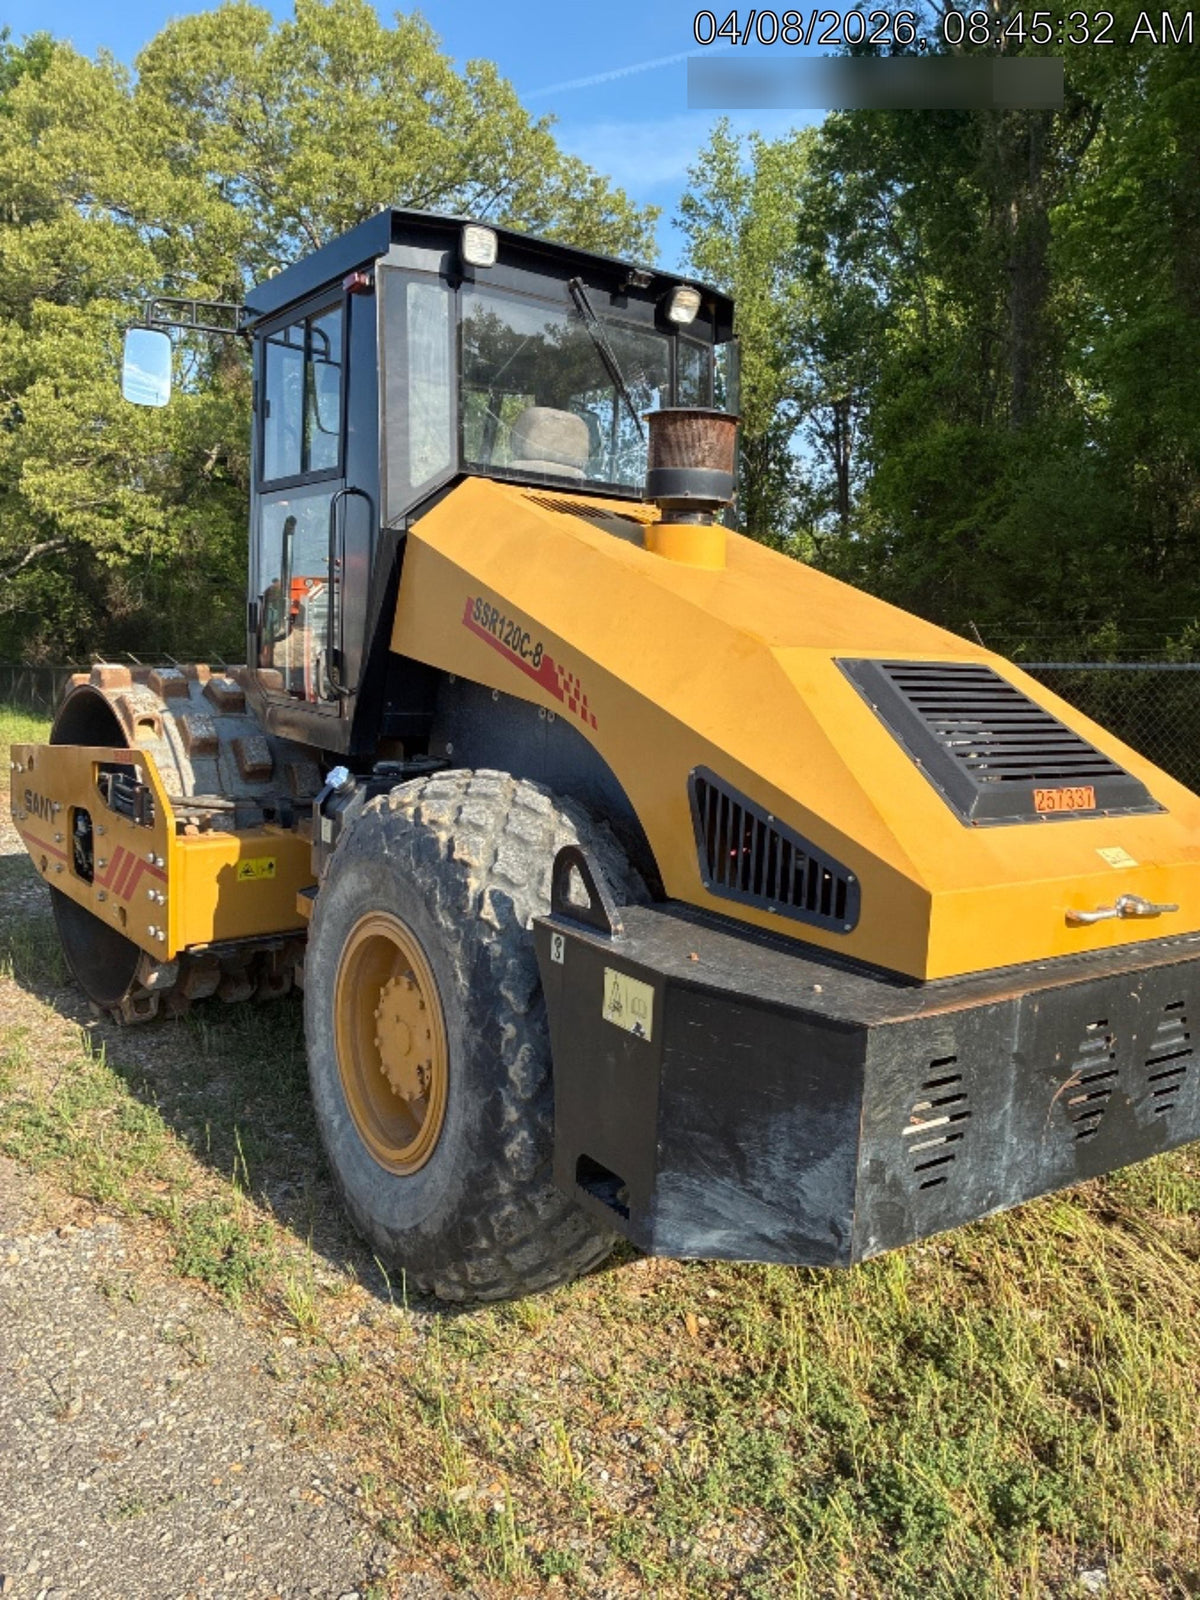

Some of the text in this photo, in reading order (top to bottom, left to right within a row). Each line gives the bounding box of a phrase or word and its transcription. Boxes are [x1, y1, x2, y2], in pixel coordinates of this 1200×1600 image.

[473, 597, 543, 668] SSR120C-8
[24, 788, 59, 824] SANY
[1036, 787, 1093, 811] 257337
